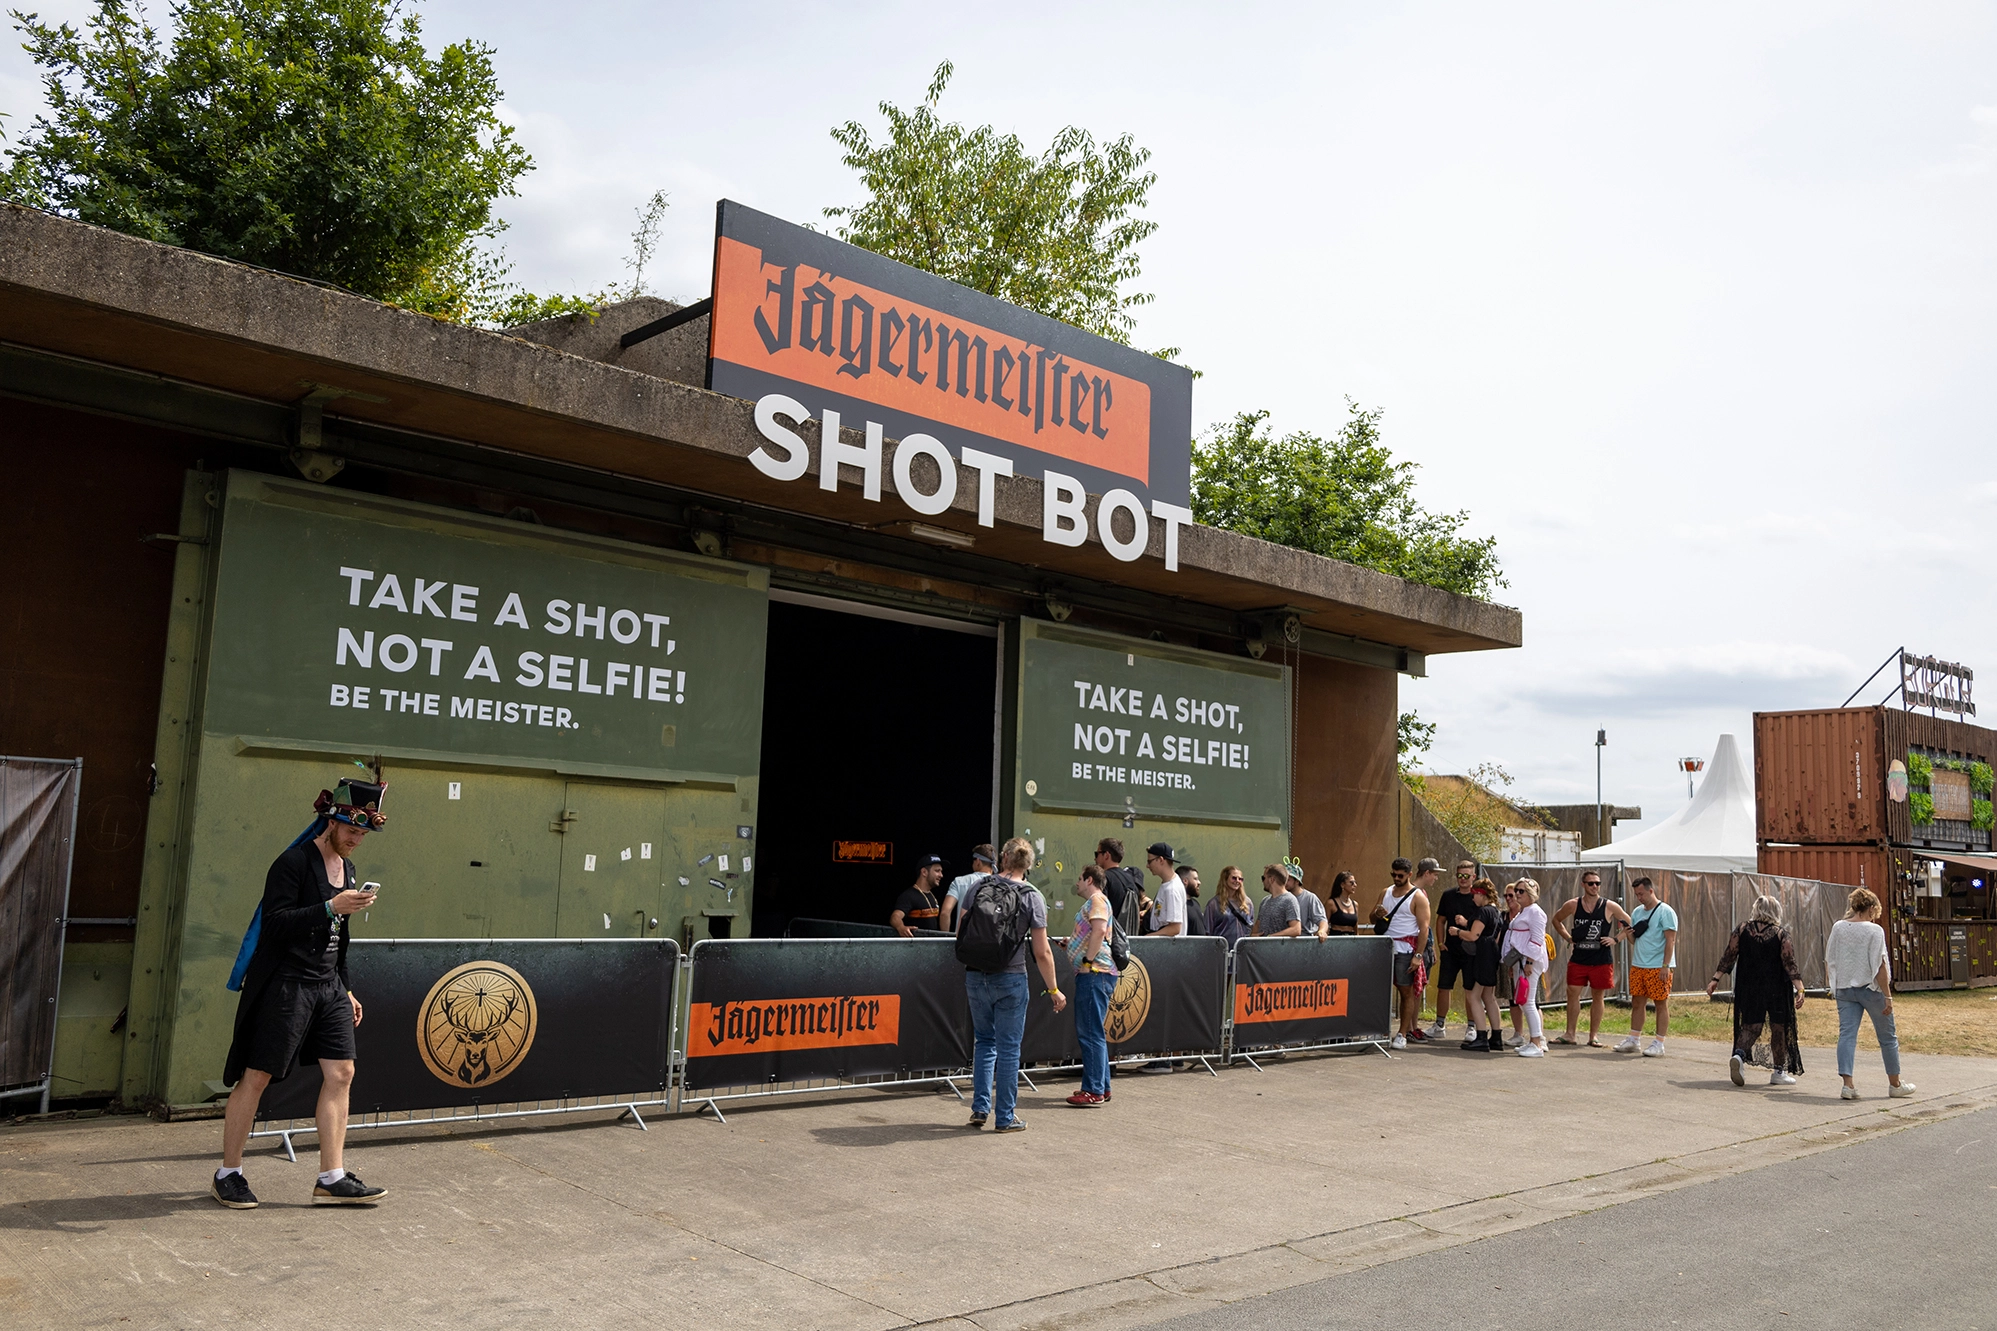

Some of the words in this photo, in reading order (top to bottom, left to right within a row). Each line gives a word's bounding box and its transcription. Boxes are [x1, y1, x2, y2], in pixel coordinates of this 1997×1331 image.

[747, 394, 1013, 528] SHOT
[1043, 470, 1193, 573] BOT
[340, 566, 479, 622] TAKE
[494, 592, 530, 630] A
[544, 599, 676, 655] SHOT,
[335, 627, 453, 676] NOT
[463, 645, 501, 683] A
[515, 651, 686, 704] SELFIE!
[330, 683, 371, 709] BE
[380, 688, 441, 716] THE
[450, 696, 580, 730] MEISTER.
[1074, 680, 1143, 717] TAKE
[1150, 693, 1168, 720] A
[1175, 697, 1243, 735] SHOT,
[1074, 722, 1131, 755] NOT
[1136, 732, 1155, 759] A
[1162, 734, 1249, 770] SELFIE!
[1072, 762, 1092, 780] BE
[1096, 764, 1126, 783] THE
[1130, 768, 1196, 790] MEISTER.
